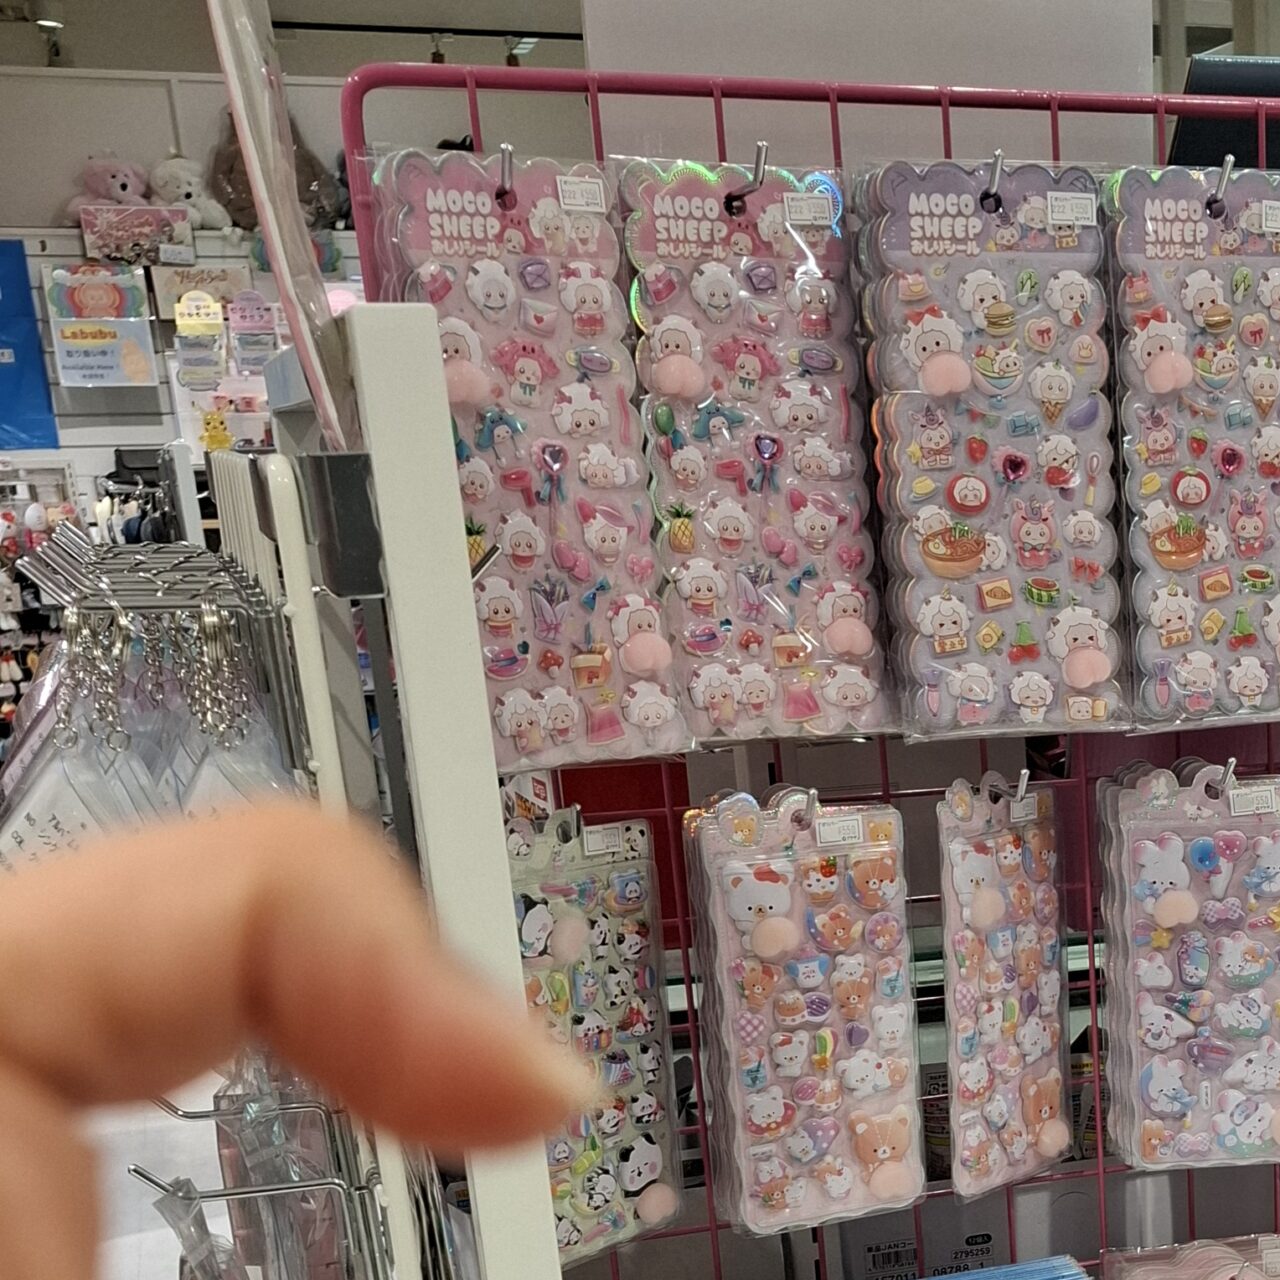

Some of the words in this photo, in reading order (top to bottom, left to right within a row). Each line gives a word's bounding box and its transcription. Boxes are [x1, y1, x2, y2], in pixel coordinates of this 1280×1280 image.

[426, 188, 492, 214] MOCO
[653, 194, 720, 219] MOCO
[908, 192, 975, 216] MOCO
[1144, 198, 1202, 221] MOCO
[428, 212, 501, 240] SHEEP
[654, 217, 728, 243] SHEEP
[909, 215, 983, 239] SHEEP
[1144, 220, 1209, 243] SHEEP
[909, 239, 982, 256] おしりシール
[1145, 243, 1207, 260] おしりシール
[60, 328, 118, 340] Labubu
[952, 1247, 991, 1260] 2795259
